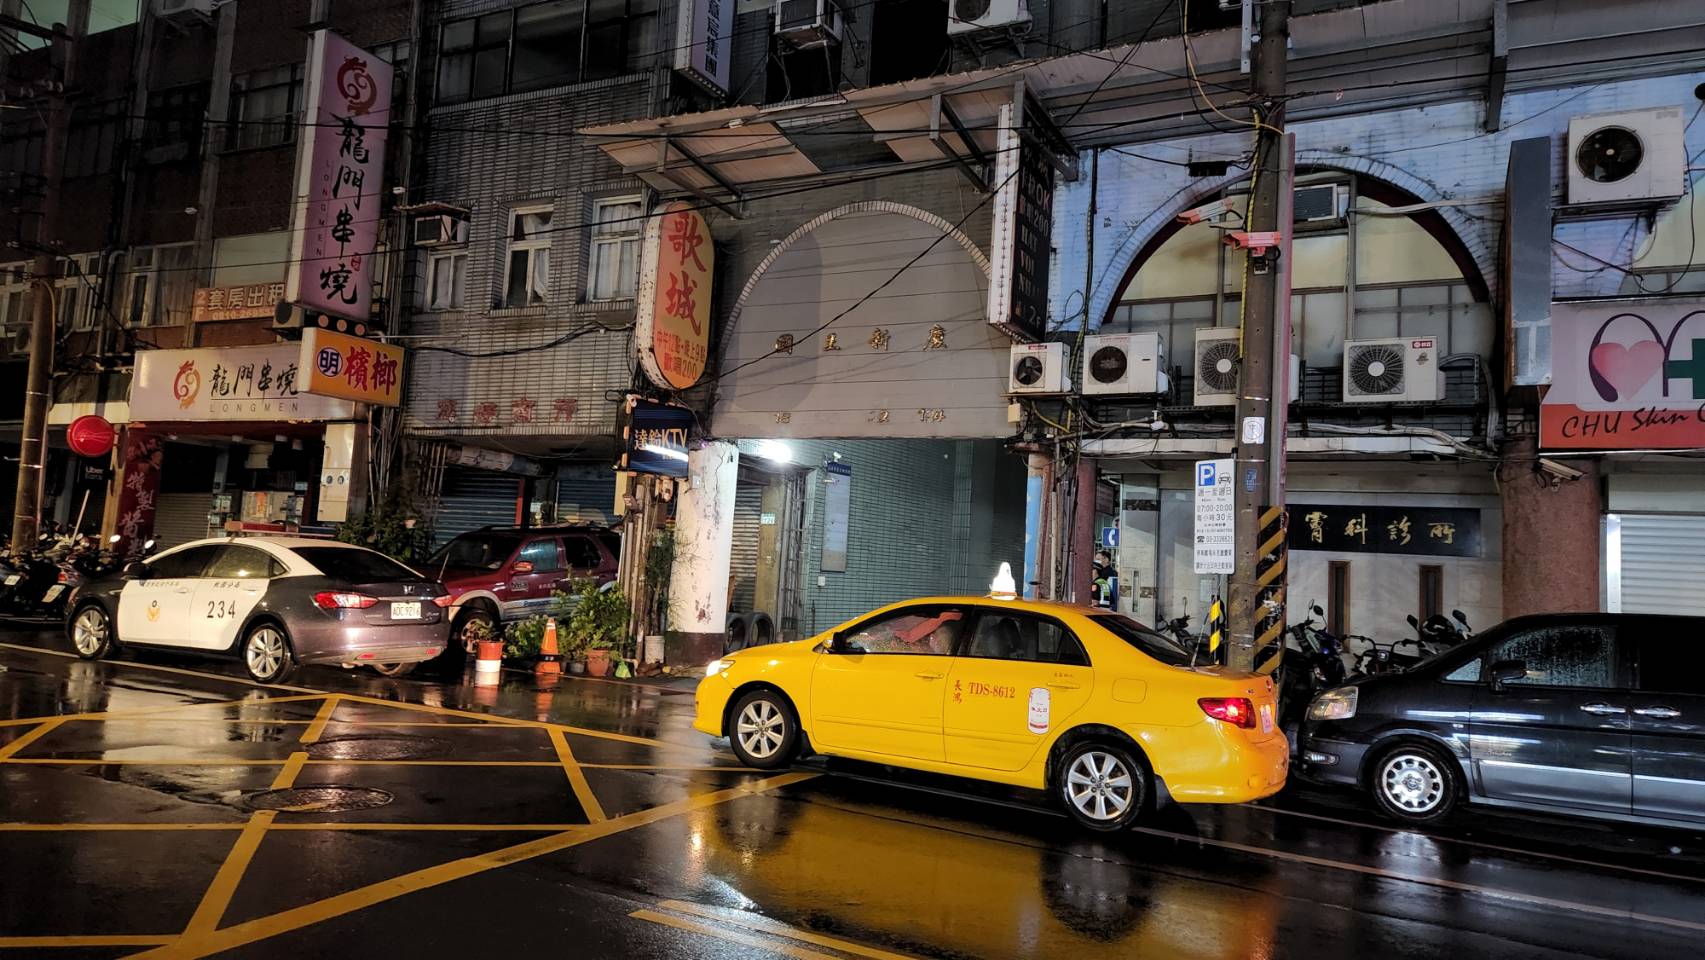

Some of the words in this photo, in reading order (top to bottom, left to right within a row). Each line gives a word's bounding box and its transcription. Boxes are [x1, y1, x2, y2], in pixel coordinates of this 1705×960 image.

[316, 160, 330, 256] LONGMEN
[320, 113, 369, 304] 龍門串燒
[665, 212, 706, 336] 歌城
[208, 284, 285, 311] 套房出租
[209, 358, 299, 400] 龍門串燒
[320, 350, 340, 375] 明
[344, 346, 398, 395] 檳榔
[210, 402, 299, 413] LONGMEN
[1562, 411, 1621, 438] CHU
[1631, 407, 1688, 431] Skin
[1200, 465, 1215, 485] P
[207, 600, 236, 619] 234
[969, 681, 1016, 700] TDS-8612
